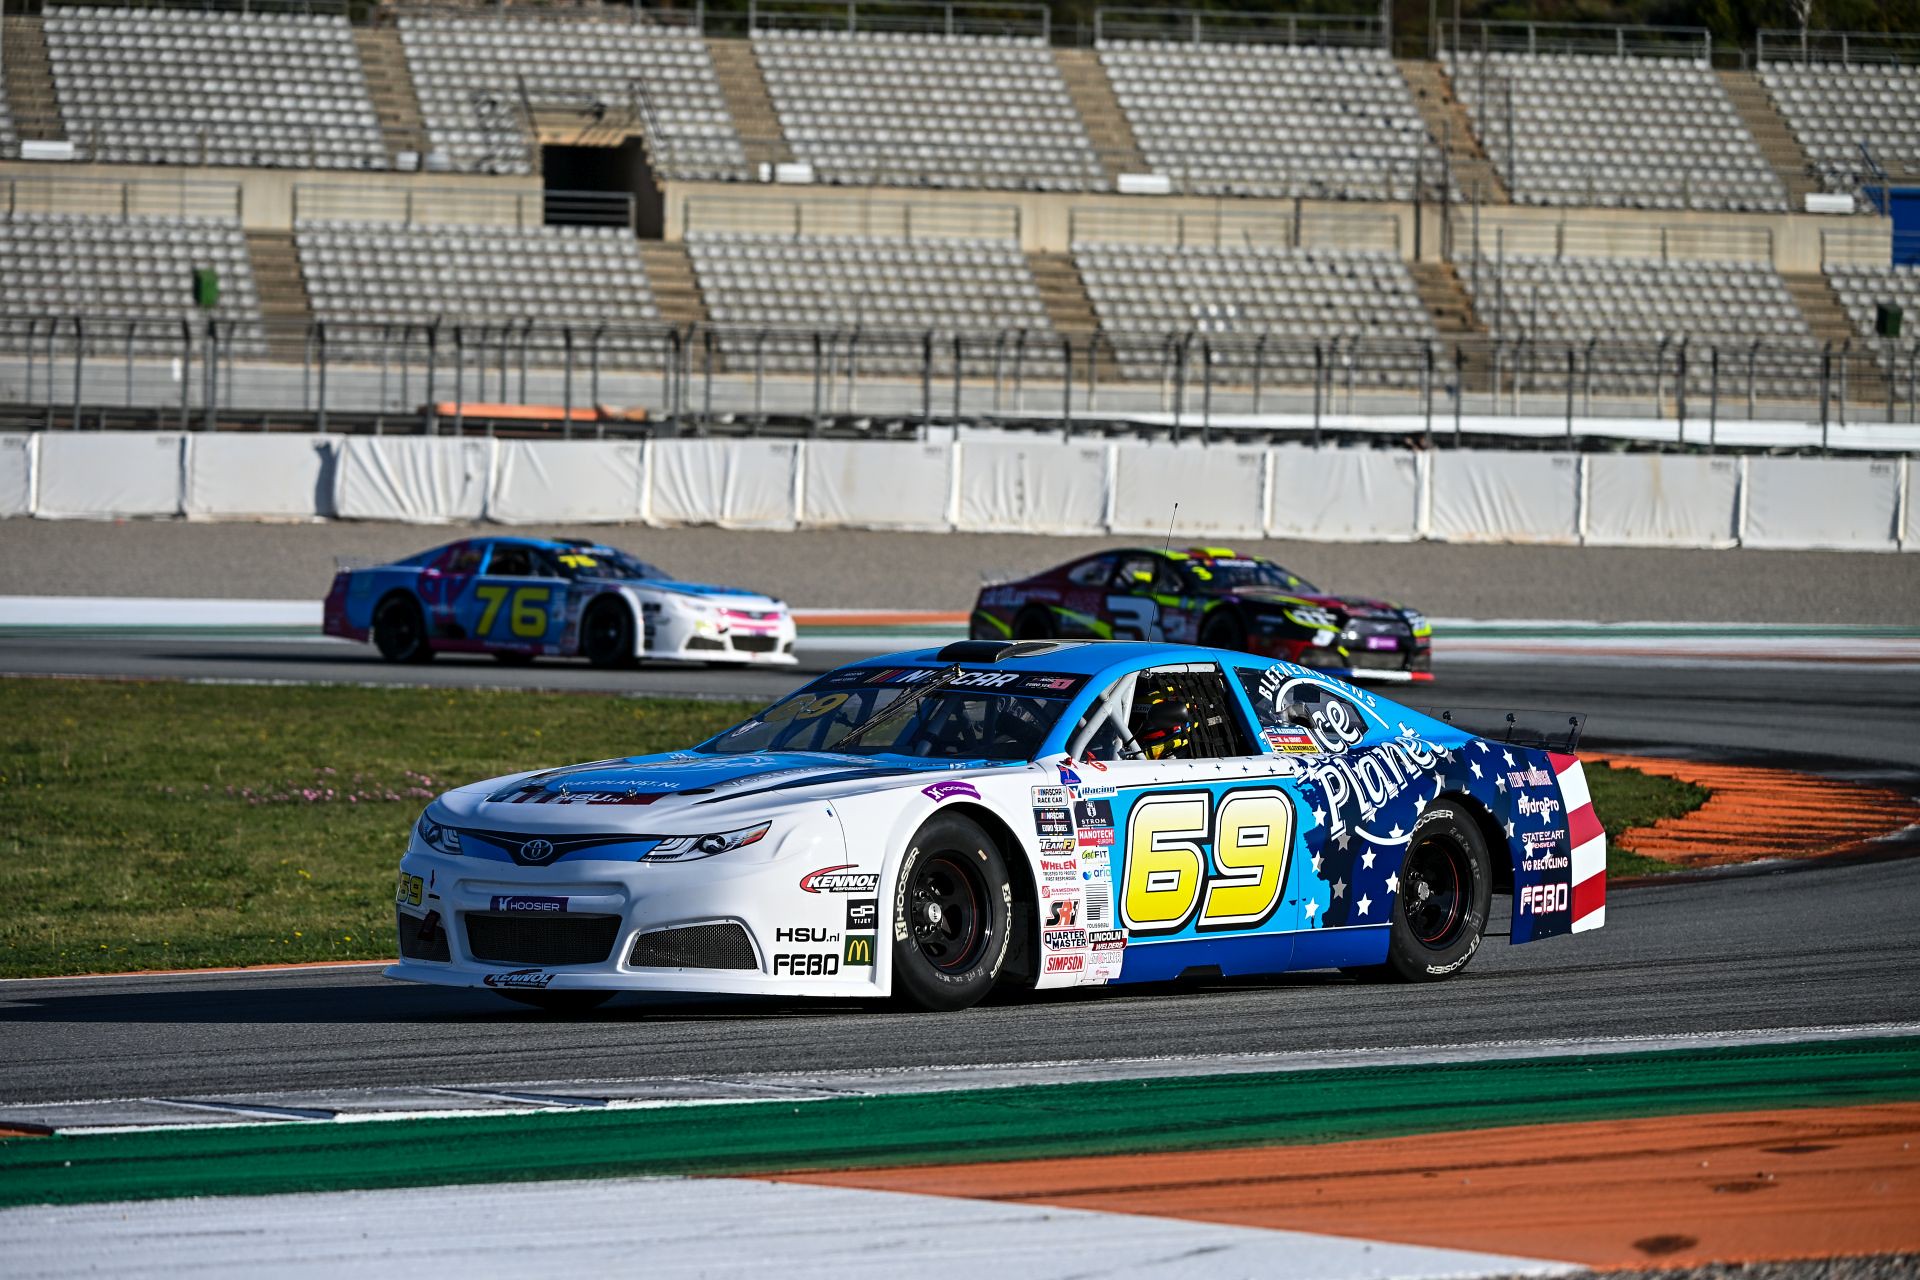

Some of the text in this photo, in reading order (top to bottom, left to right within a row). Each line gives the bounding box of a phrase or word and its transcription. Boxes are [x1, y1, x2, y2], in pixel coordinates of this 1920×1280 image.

[475, 586, 549, 637] 76
[896, 669, 1019, 688] NCAR
[1314, 722, 1448, 841] Planet
[1082, 785, 1115, 795] iRacing
[1518, 797, 1560, 816] HydroPro
[1079, 829, 1113, 839] NANOTECH
[1522, 831, 1544, 843] STATE
[1550, 830, 1565, 840] ART
[1040, 859, 1077, 870] WHELEN
[1121, 786, 1297, 937] 69
[1522, 857, 1568, 871] VG RECYCLING
[807, 875, 876, 888] KENNOL
[1520, 882, 1568, 915] FEBO
[510, 902, 560, 911] HOOSIER
[776, 928, 840, 942] HSU.nl
[1045, 931, 1085, 944] QUARTER
[1089, 931, 1122, 942] LINCOLN
[1052, 939, 1087, 949] MASTER
[1095, 942, 1124, 950] WELDERS
[774, 954, 839, 975] FEBO
[1047, 955, 1084, 971] SIMPSON
